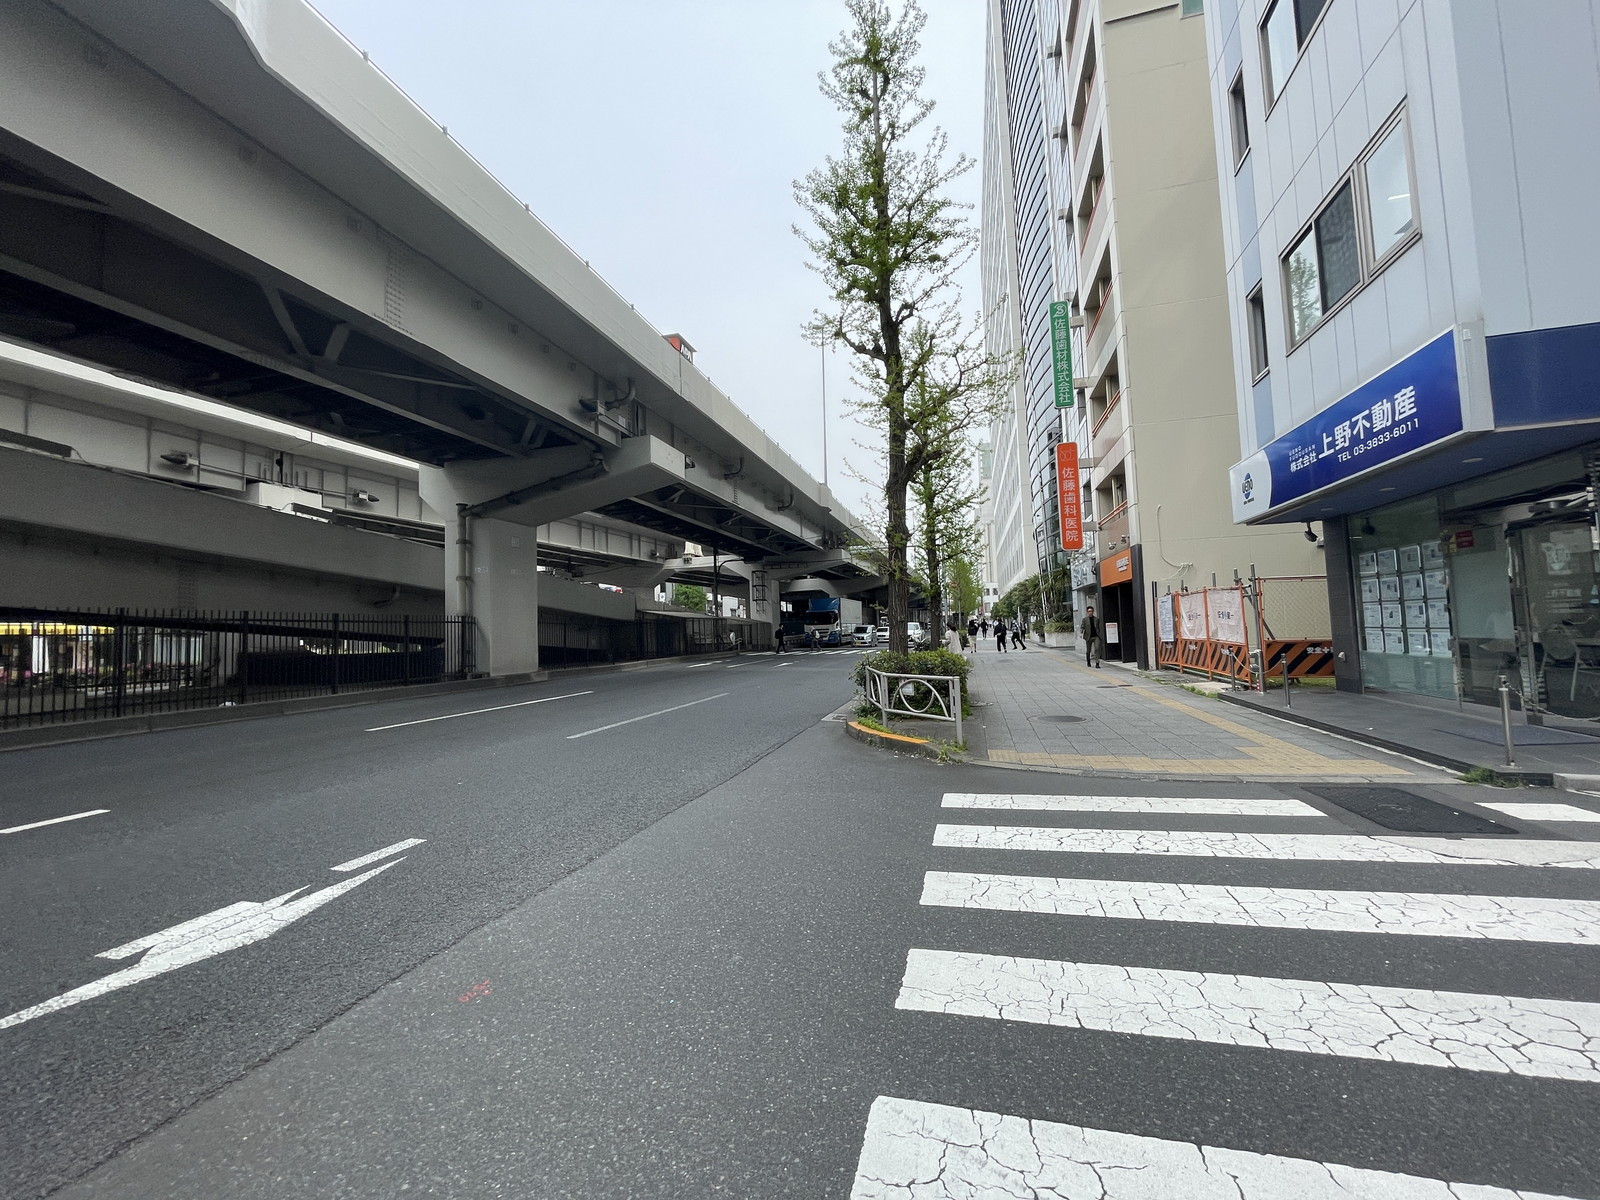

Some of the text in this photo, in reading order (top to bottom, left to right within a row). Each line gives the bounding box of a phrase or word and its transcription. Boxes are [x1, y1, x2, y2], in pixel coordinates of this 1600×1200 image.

[1054, 318, 1071, 403] 佐藤歯材株式会社
[1318, 385, 1417, 459] 上野不動産
[1337, 418, 1419, 463] TEL 03-3833-6011
[1290, 450, 1318, 473] 株式会社
[1061, 466, 1079, 542] 佐藤歯科医院
